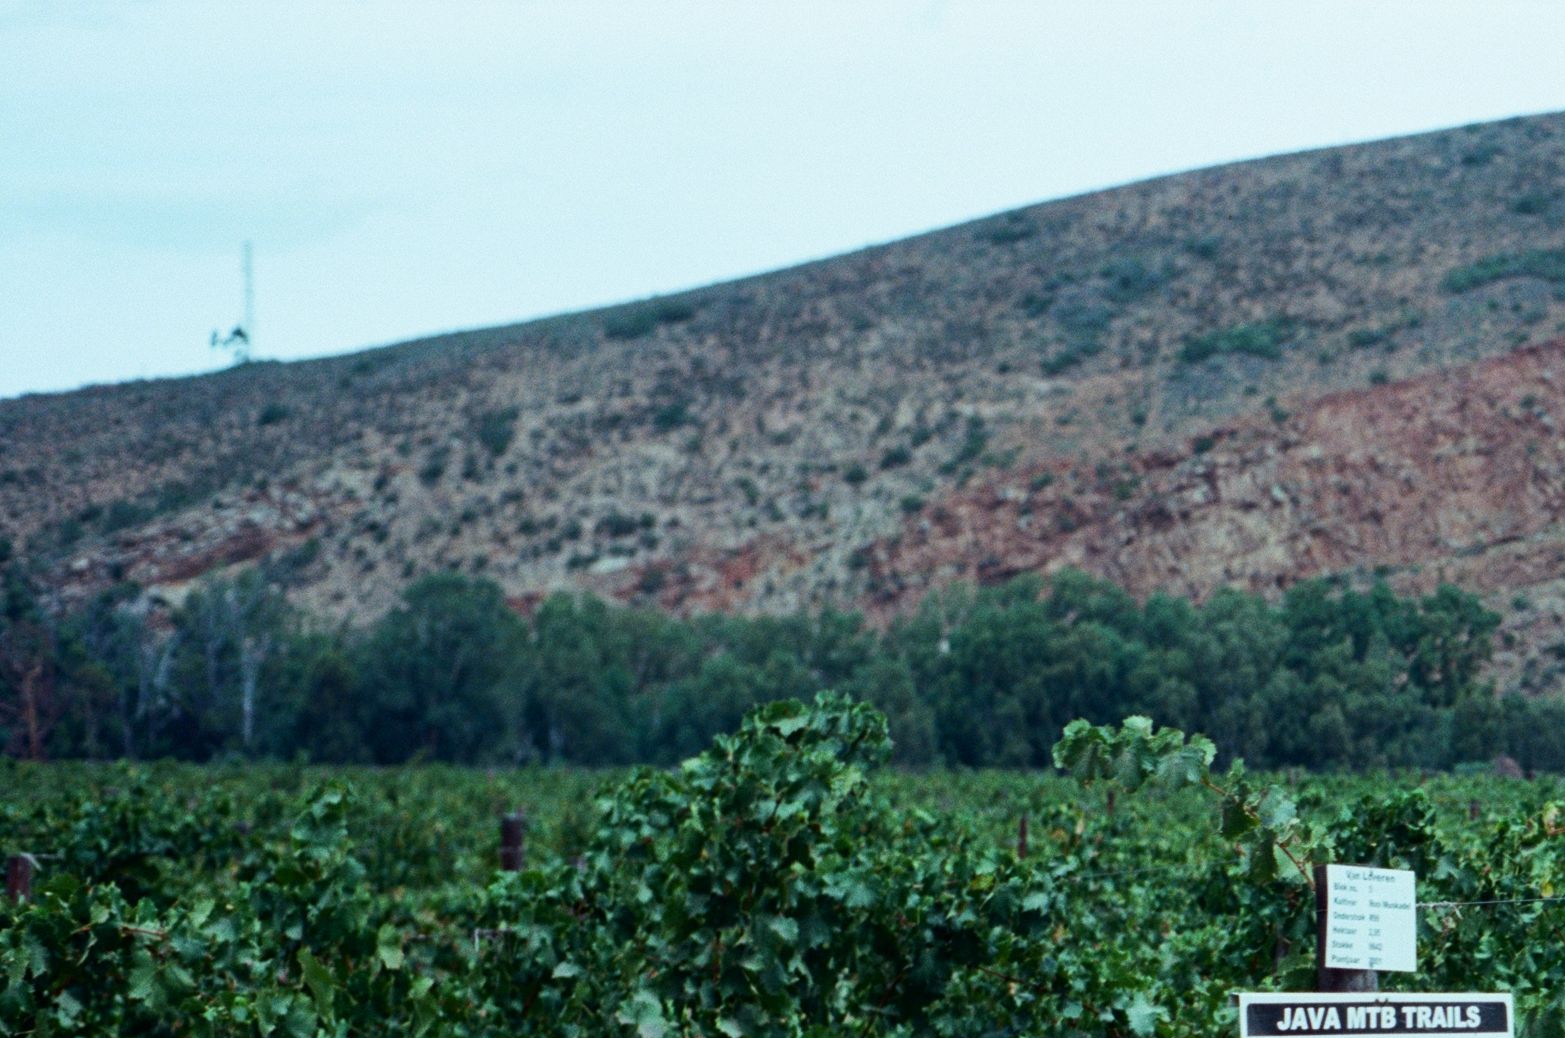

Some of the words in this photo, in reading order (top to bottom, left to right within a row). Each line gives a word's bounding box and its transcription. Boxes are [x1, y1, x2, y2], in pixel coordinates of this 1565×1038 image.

[1277, 1006, 1341, 1031] JAVA
[1346, 1005, 1397, 1030] MTB
[1401, 1004, 1482, 1029] TRAILS
